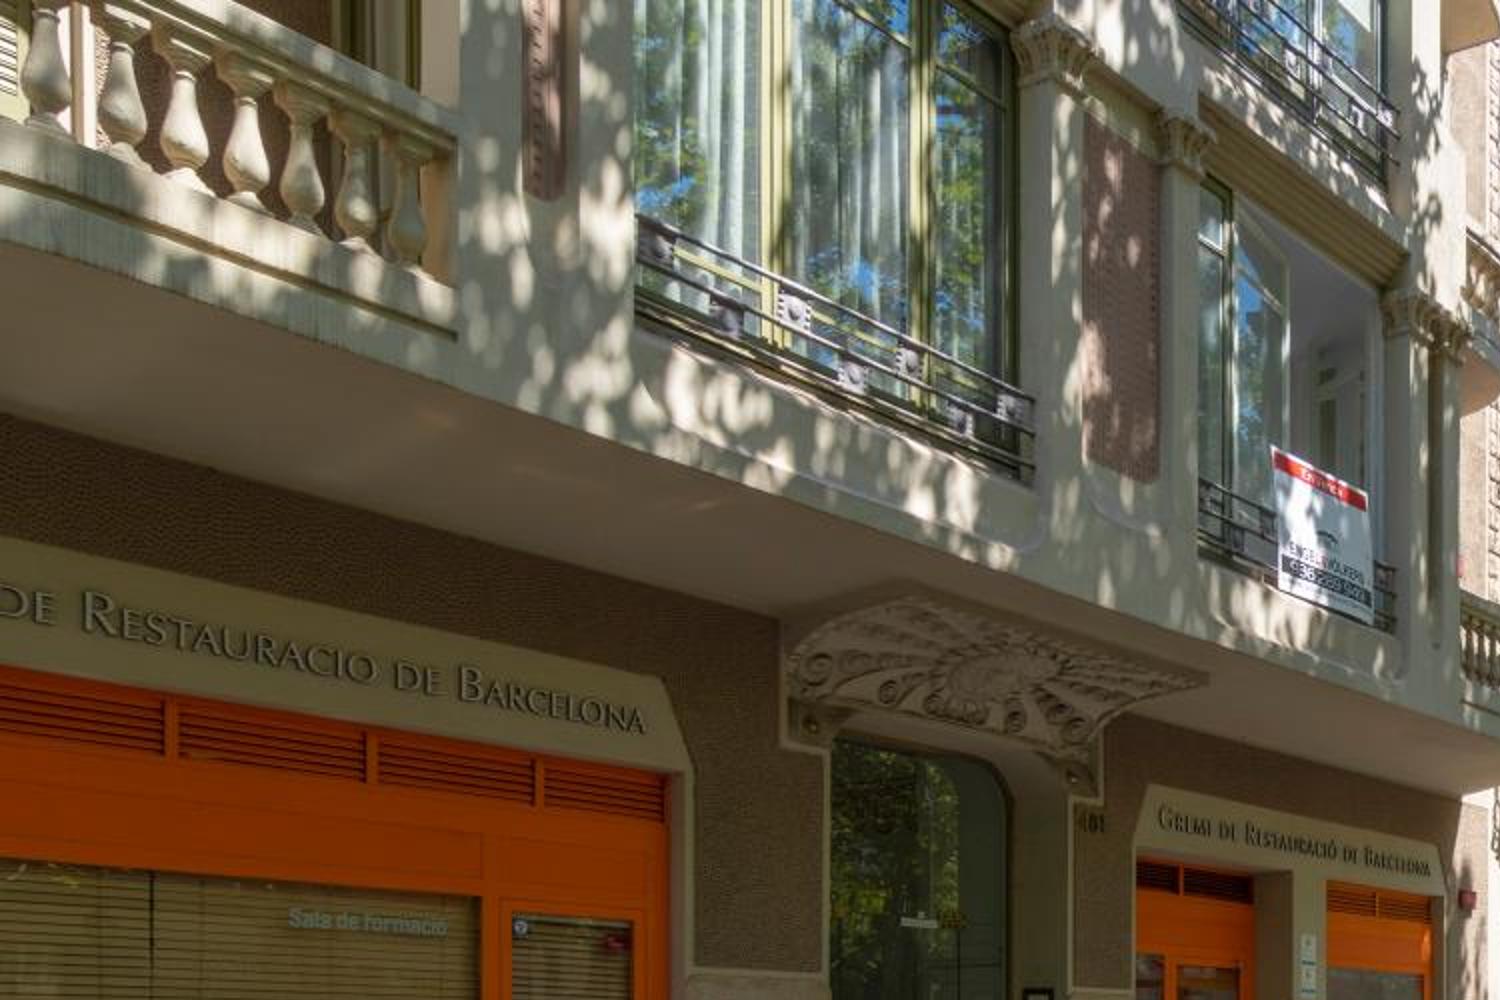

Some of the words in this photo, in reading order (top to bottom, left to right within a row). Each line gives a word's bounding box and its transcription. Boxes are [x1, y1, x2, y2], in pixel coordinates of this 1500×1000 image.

[395, 660, 448, 696] DE
[457, 665, 648, 735] BARCELONA
[1219, 820, 1237, 842] DE
[1342, 846, 1358, 865] DE
[1364, 846, 1432, 877] BARCELONA
